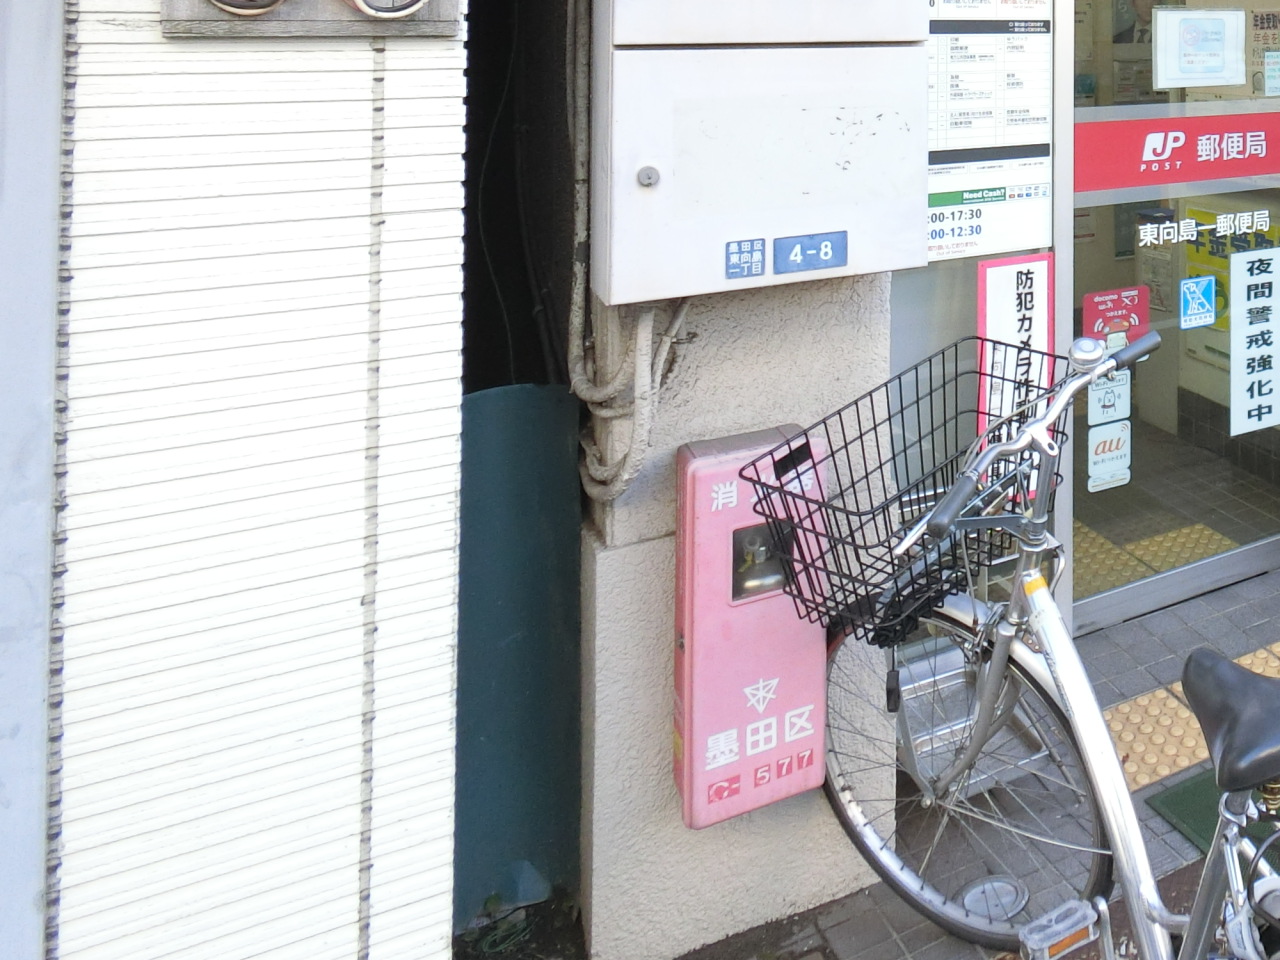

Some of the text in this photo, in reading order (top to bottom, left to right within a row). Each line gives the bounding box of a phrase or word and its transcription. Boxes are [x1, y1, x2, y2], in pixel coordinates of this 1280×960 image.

[1142, 131, 1185, 161] JP
[1197, 131, 1266, 162] 郵便局
[1140, 161, 1182, 172] POST
[962, 188, 1005, 200] Need Cash?
[1139, 210, 1270, 247] 東向島一郵便局
[729, 251, 763, 265] 東向島
[789, 241, 833, 263] 4-8
[729, 263, 762, 276] 一丁目
[1094, 294, 1118, 302] docomo
[1015, 269, 1035, 426] 防犯カメラ作動
[1246, 258, 1274, 423] 夜間警戒強化中
[1094, 437, 1126, 457] au
[705, 704, 815, 769] 墨田区
